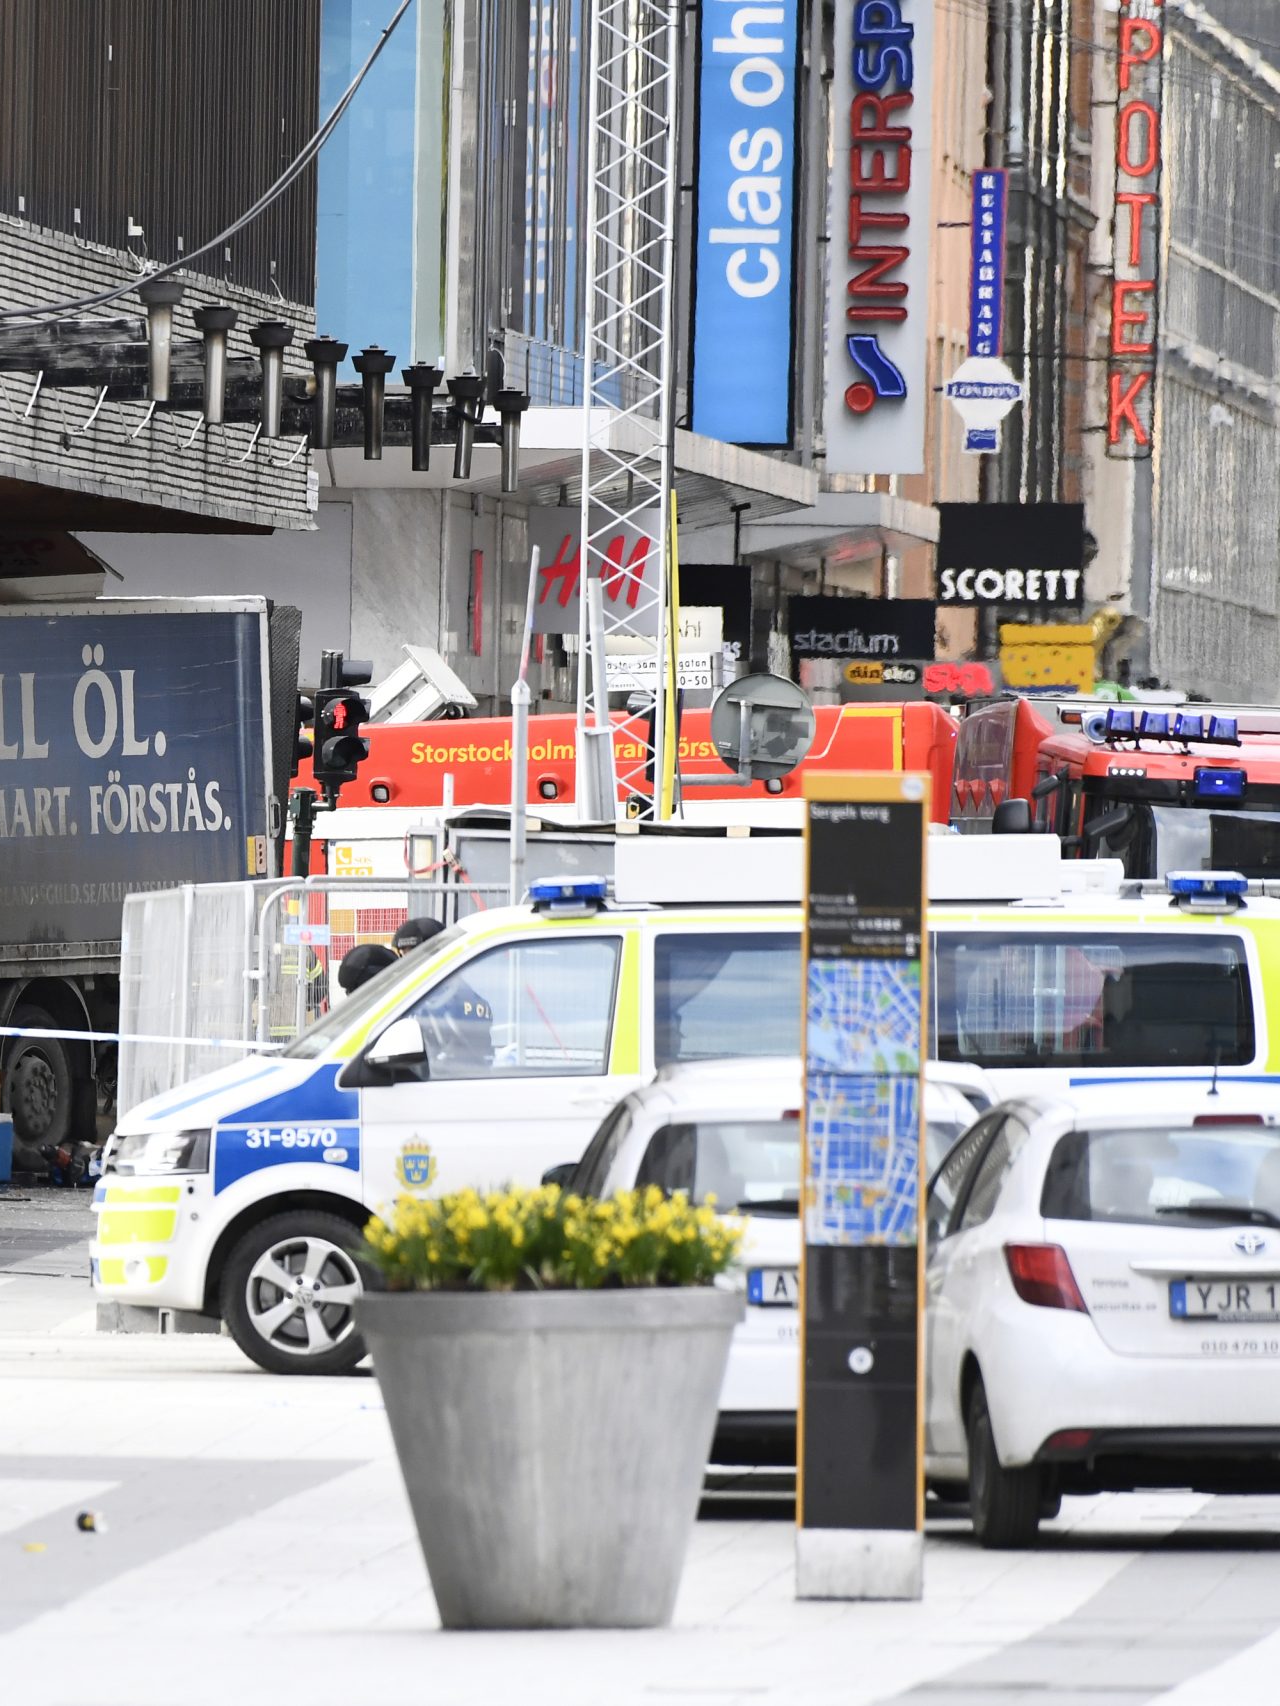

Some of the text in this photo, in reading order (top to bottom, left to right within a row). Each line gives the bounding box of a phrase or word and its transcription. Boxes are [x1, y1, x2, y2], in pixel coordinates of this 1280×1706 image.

[710, 0, 785, 299] clas oh
[847, 0, 914, 322] INTERSP
[976, 174, 997, 355] RESTAURANG
[1108, 16, 1163, 446] POTEK
[539, 534, 651, 609] HM
[939, 567, 1081, 601] SCORETT
[793, 627, 899, 654] stadium
[72, 643, 167, 759] ÖL.
[677, 675, 708, 686] 0-50
[411, 738, 576, 764] Storstockolm
[89, 766, 232, 836] FÖRSTÅS.
[246, 1127, 338, 1149] 31-9570
[1197, 1284, 1251, 1311] YJR
